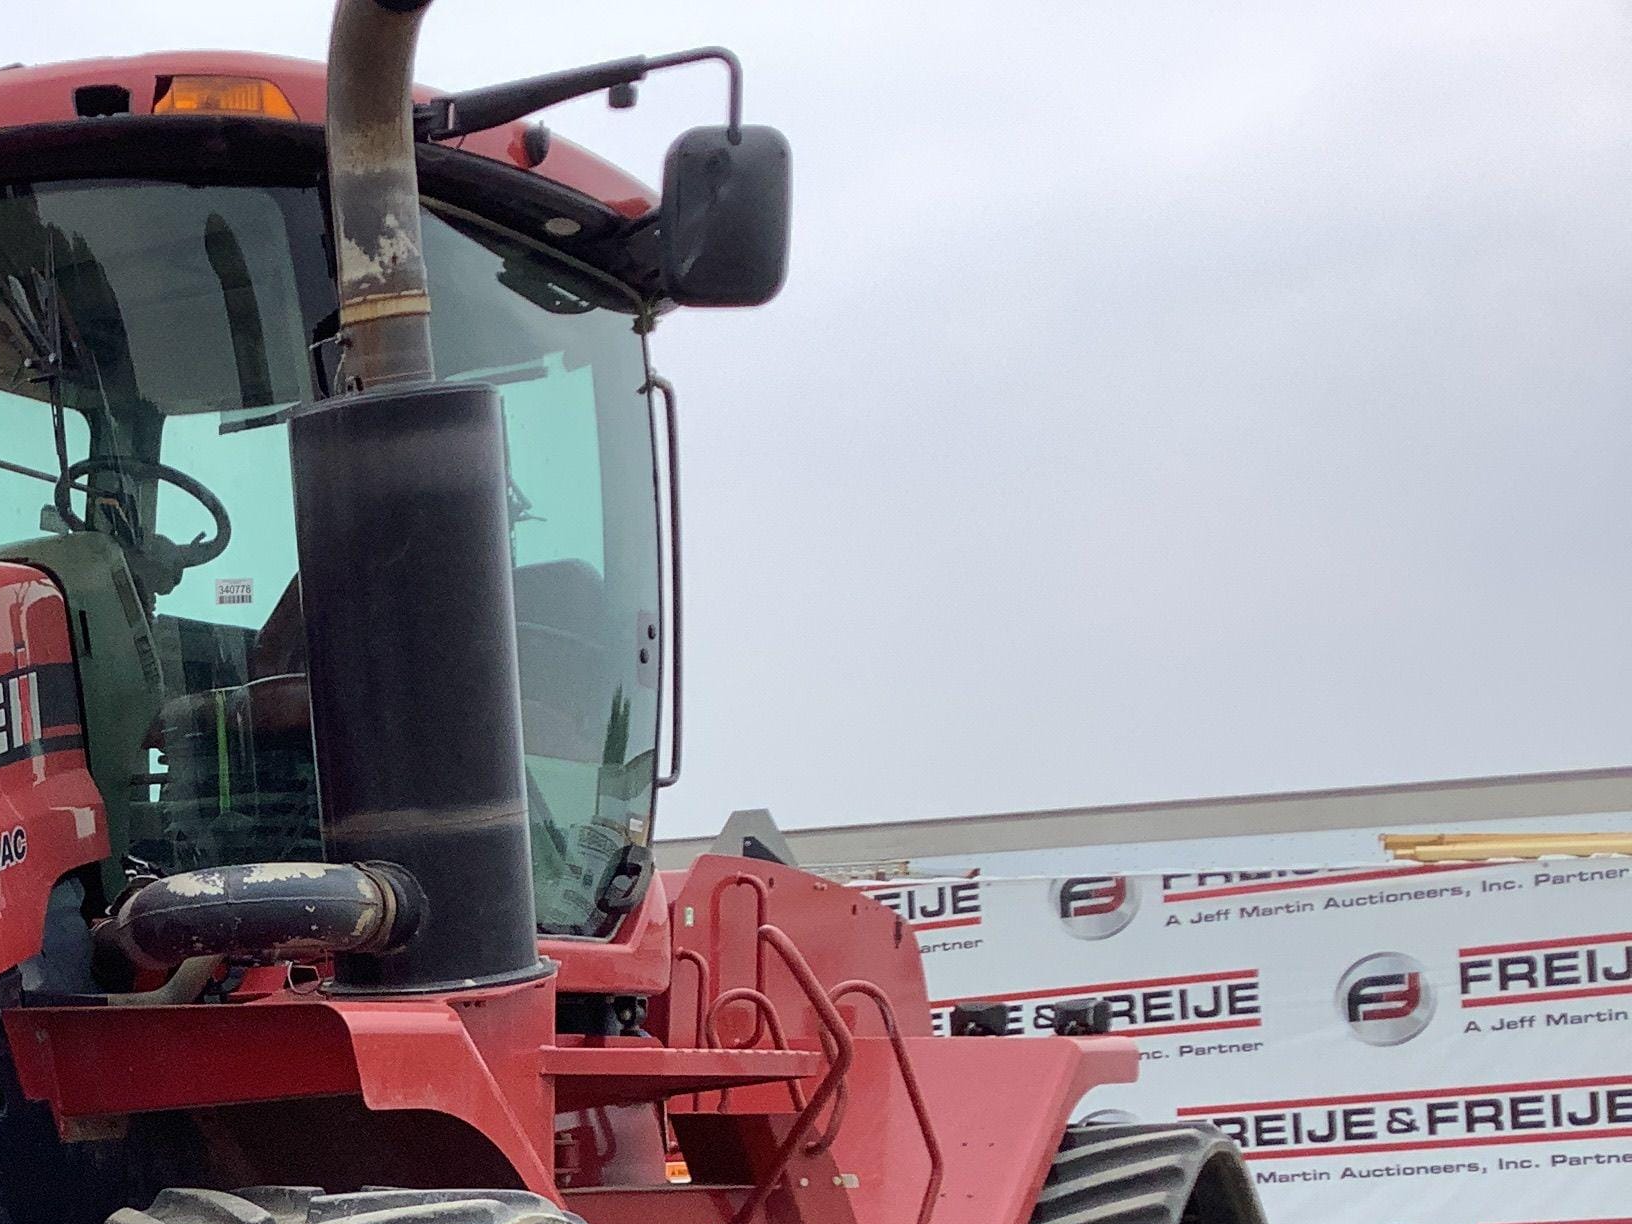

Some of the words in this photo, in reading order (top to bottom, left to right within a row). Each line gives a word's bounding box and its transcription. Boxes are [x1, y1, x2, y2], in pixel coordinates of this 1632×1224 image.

[1165, 914, 1181, 927] A
[1189, 908, 1231, 924] Jeff
[1239, 901, 1315, 919] Martin
[1323, 885, 1471, 910] Auctioneers,
[1481, 879, 1523, 893] Inc.
[1534, 867, 1630, 887] Partner
[920, 940, 984, 953] artner
[1072, 982, 1262, 1026] REIJE
[1464, 1020, 1481, 1033] A
[1491, 1014, 1536, 1031] Jeff
[1546, 1008, 1628, 1026] Martin
[1139, 1050, 1169, 1060] nc.
[1179, 1040, 1264, 1057] Partner
[1180, 1107, 1378, 1148] REIJE
[1386, 1107, 1420, 1135] &
[1427, 1088, 1632, 1135] FREIJE
[1256, 1167, 1330, 1184] Martin
[1340, 1161, 1488, 1180] Auctioneers,
[1498, 1156, 1541, 1171] Inc.
